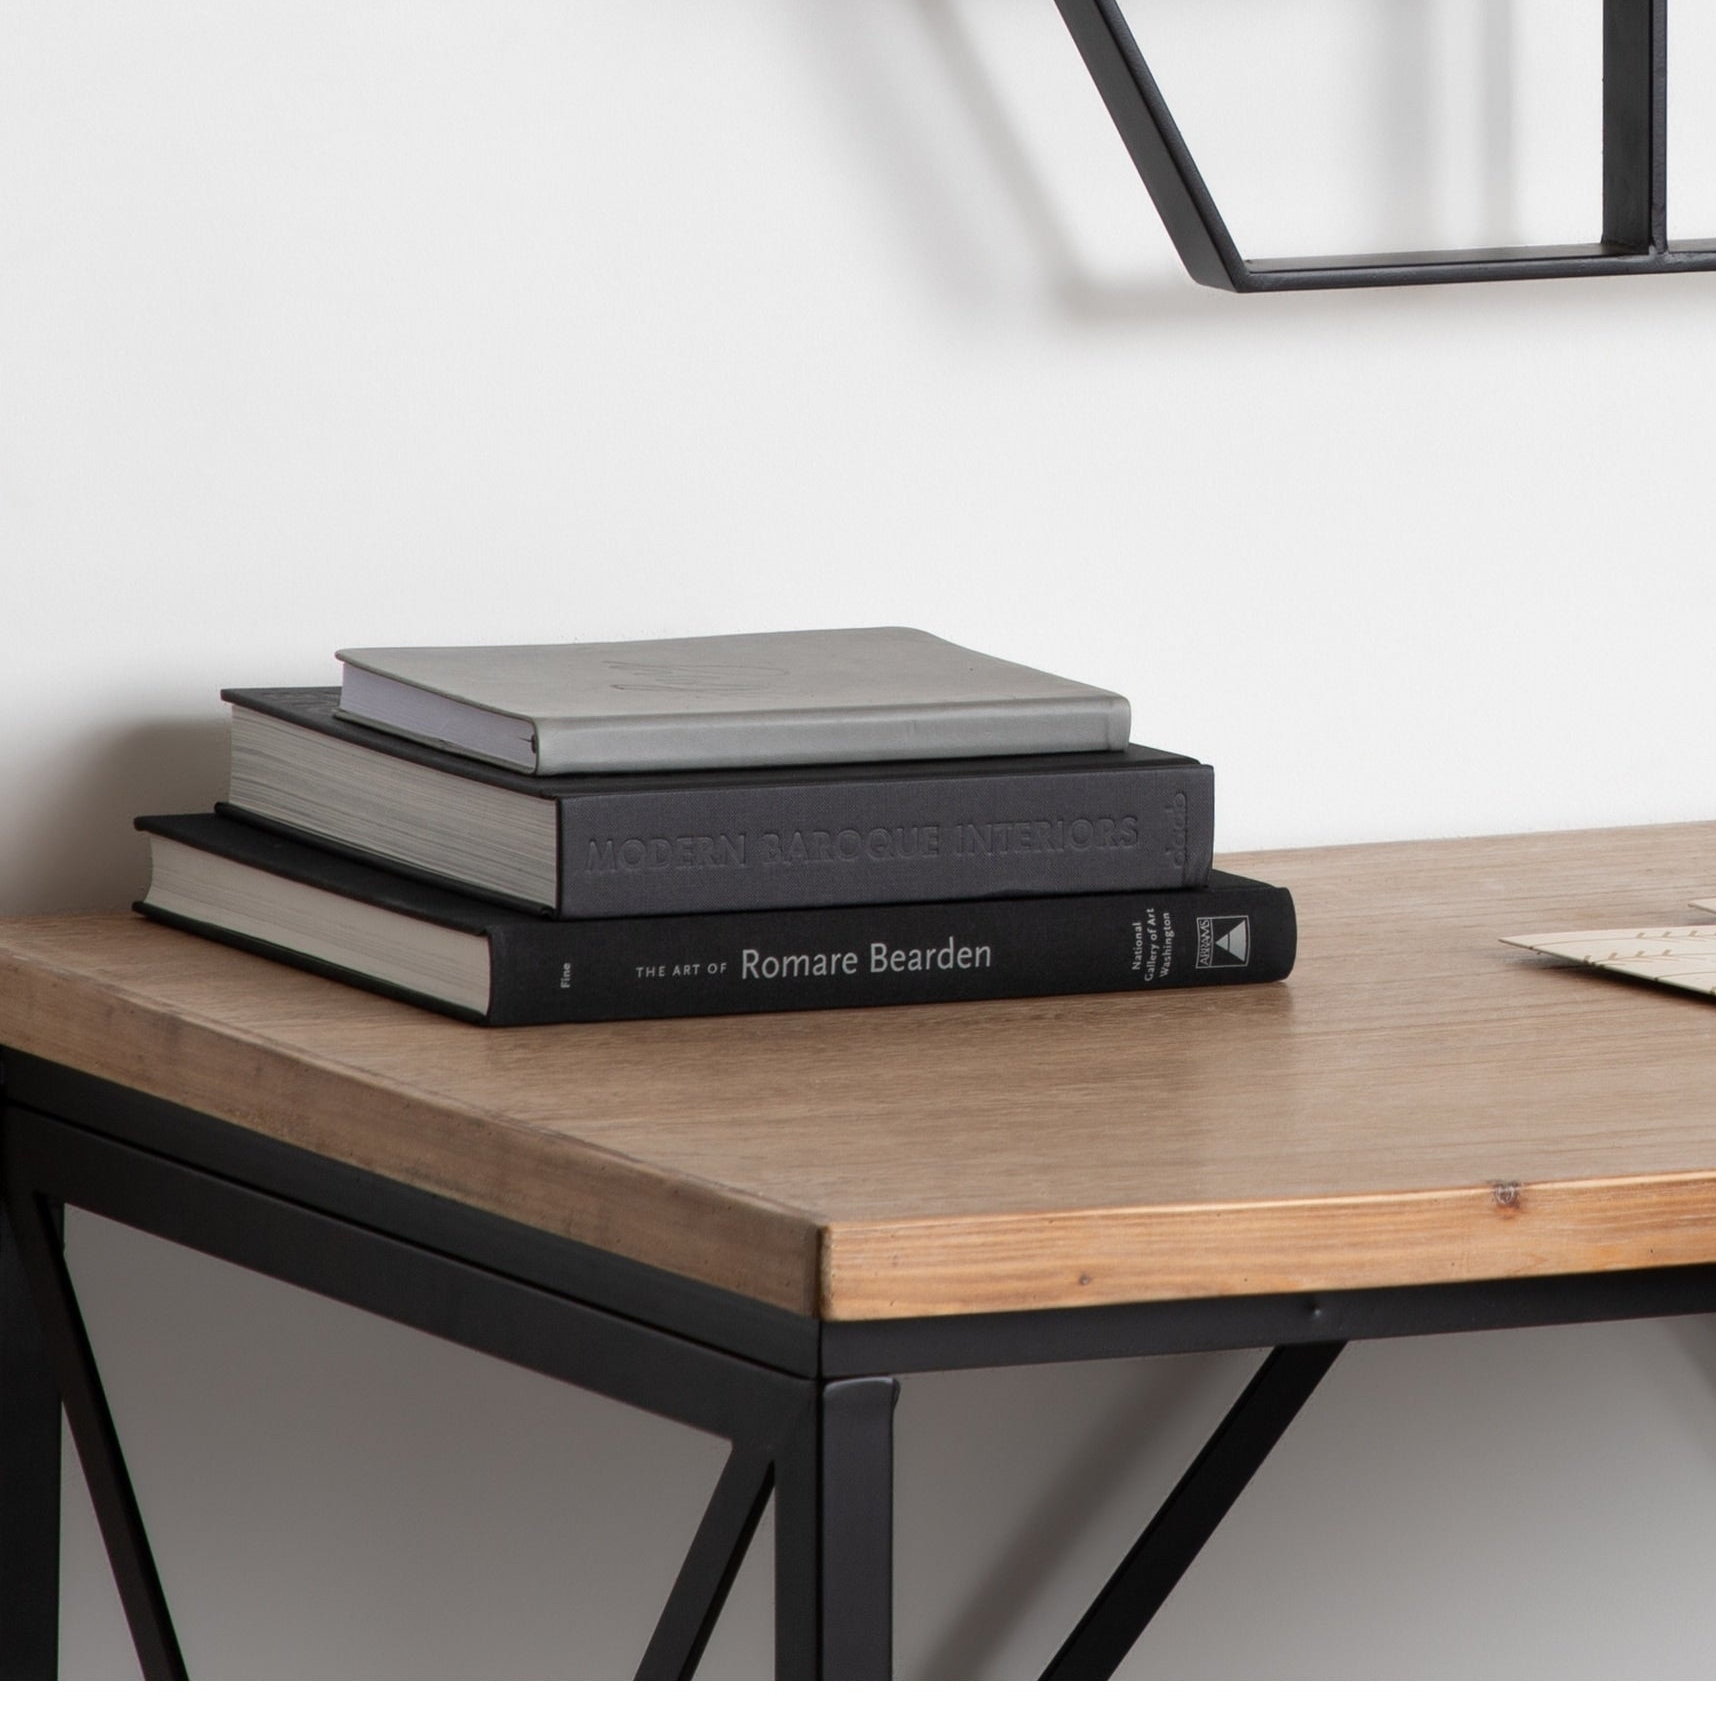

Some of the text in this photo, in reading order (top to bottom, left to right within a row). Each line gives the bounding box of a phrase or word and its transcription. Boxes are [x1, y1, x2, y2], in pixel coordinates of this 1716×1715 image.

[584, 816, 1140, 874] MODERN BAROQUE INTERIORS
[635, 935, 992, 981] THE ART OF Romare Bearden
[1131, 922, 1143, 971] National
[1144, 907, 1160, 981] Gallery of Art
[1159, 912, 1175, 978] Washington
[1200, 918, 1211, 966] ABRAMS
[560, 962, 571, 989] Fine
